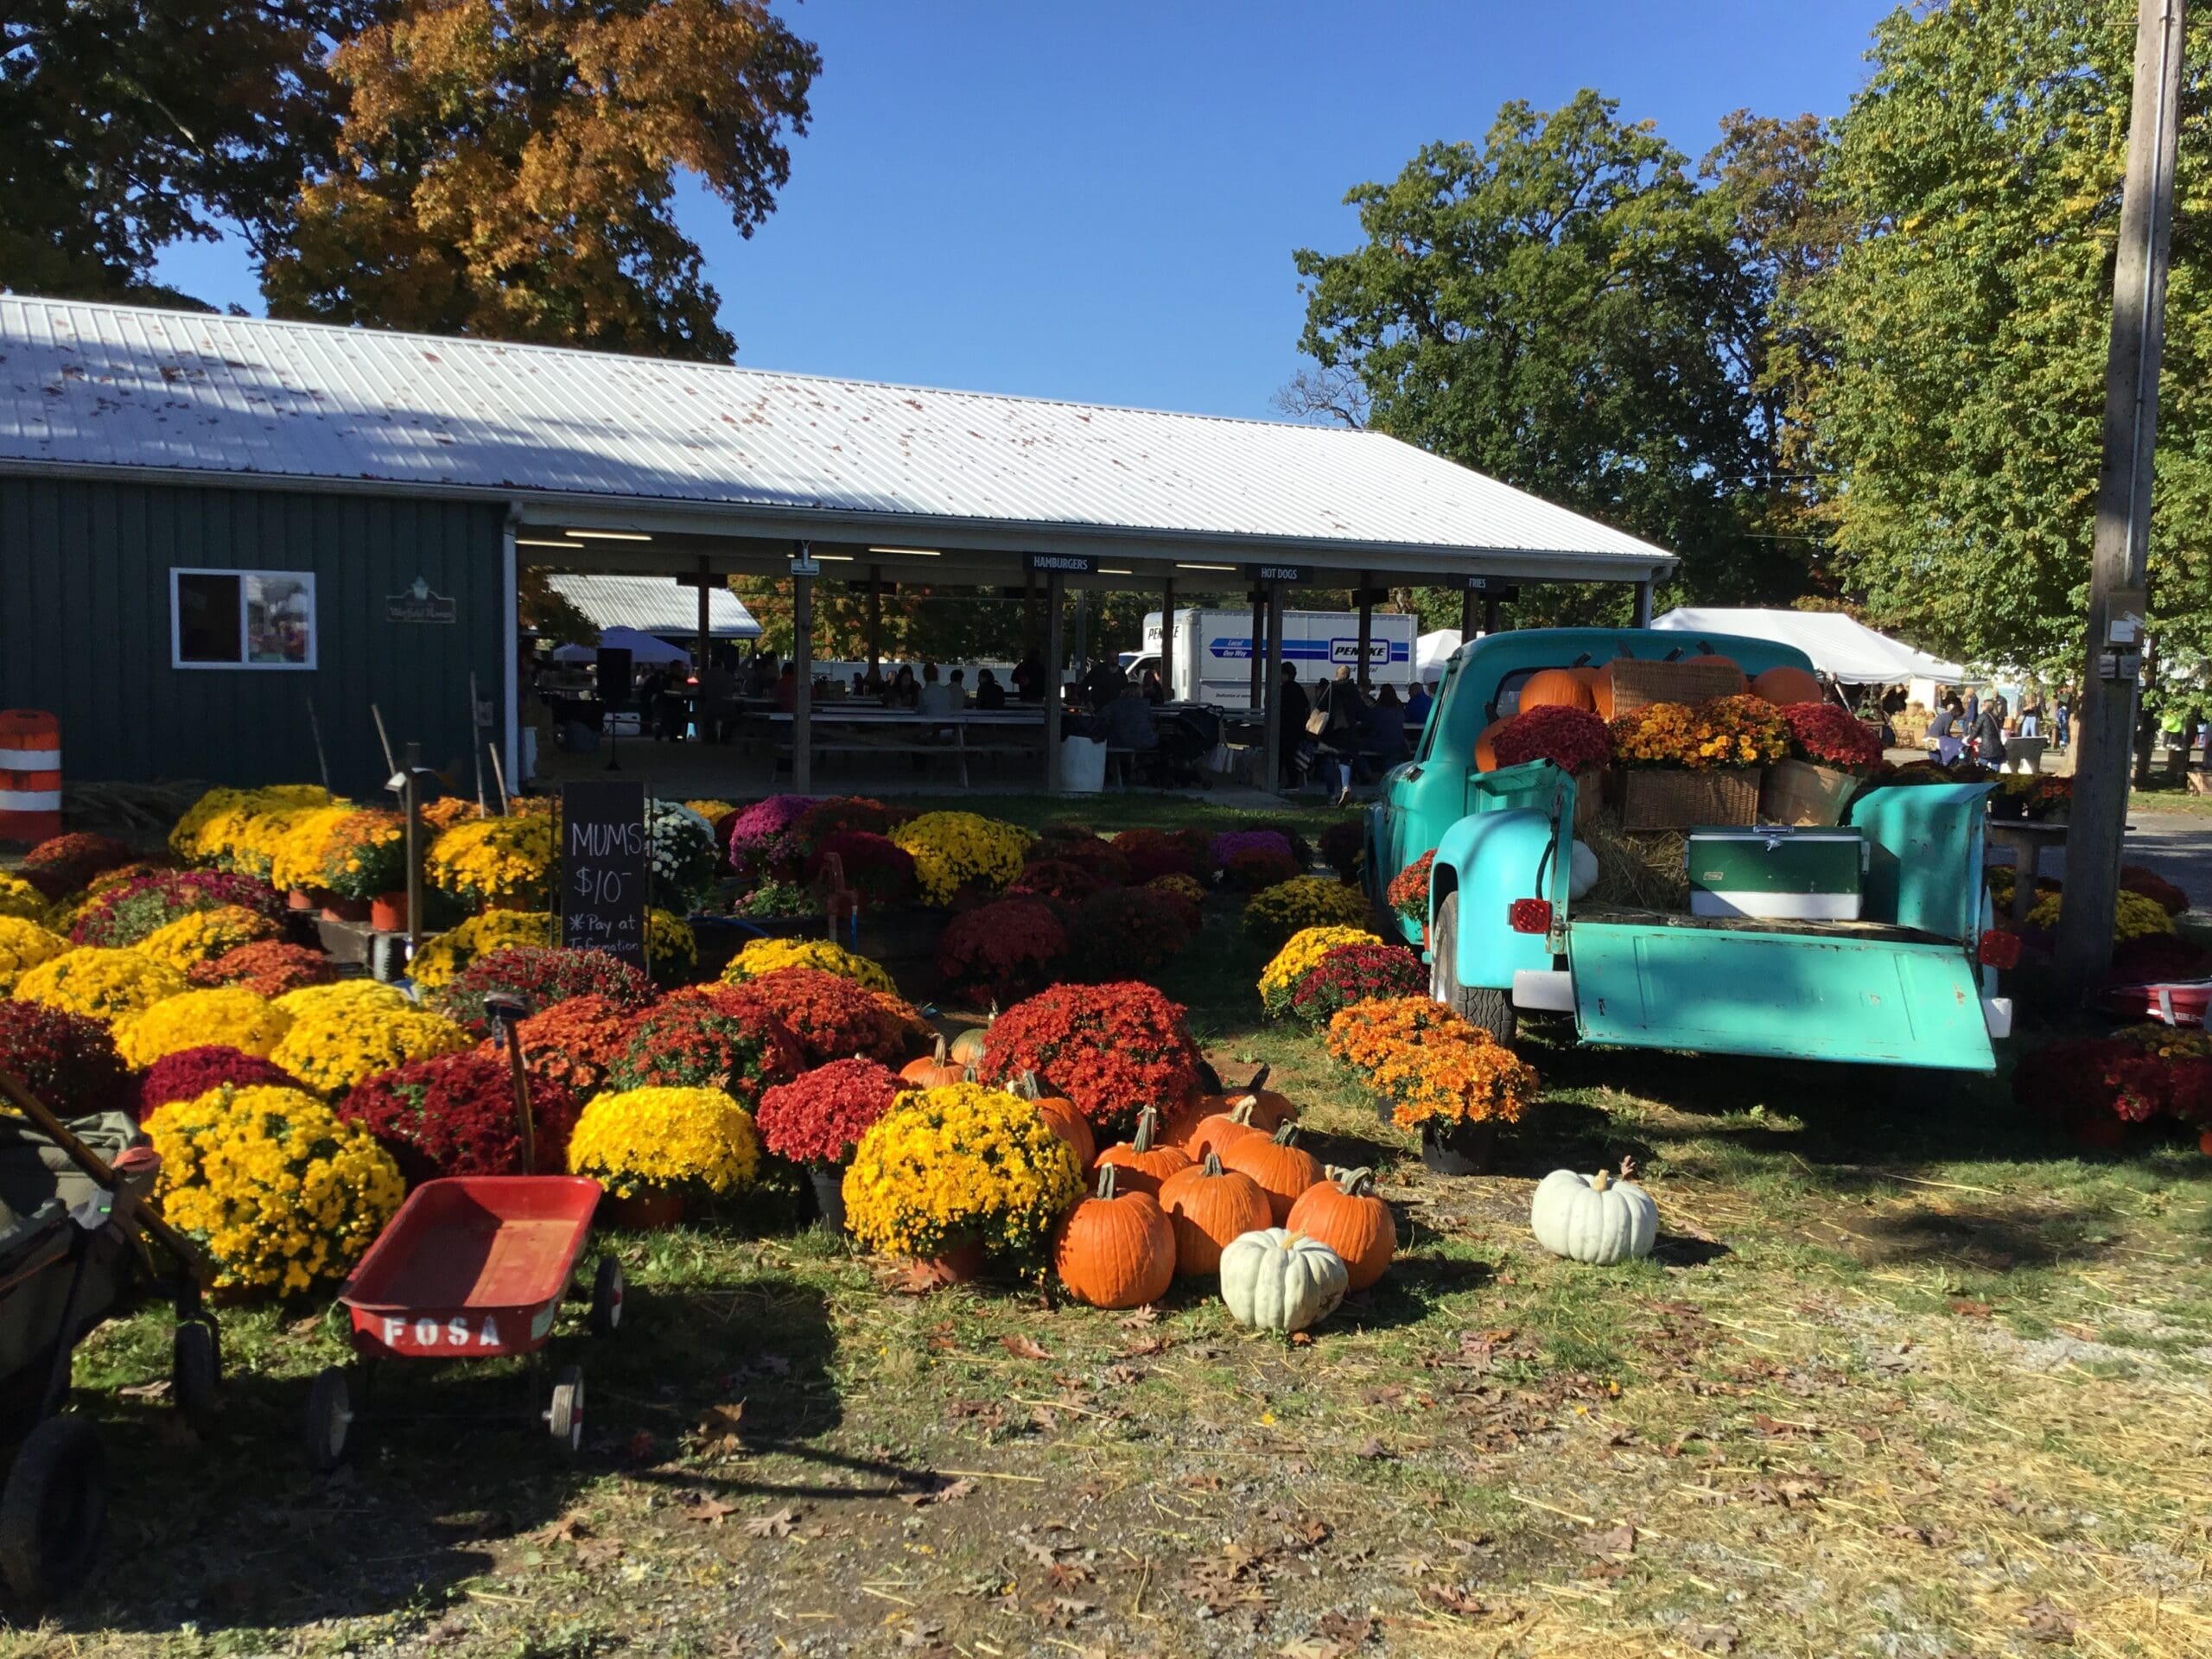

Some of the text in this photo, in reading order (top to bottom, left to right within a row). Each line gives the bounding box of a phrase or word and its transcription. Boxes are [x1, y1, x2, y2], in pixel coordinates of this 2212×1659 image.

[1033, 556, 1088, 570] HAMBURGERS
[1261, 567, 1298, 580] HOT DOGS
[1469, 577, 1486, 588] FRIES
[1147, 626, 1179, 640] PENE
[1334, 646, 1386, 657] PENKE
[572, 822, 643, 857] MUMS
[618, 913, 636, 931] at
[569, 937, 639, 952] Infmation
[382, 1313, 502, 1347] FOSA
